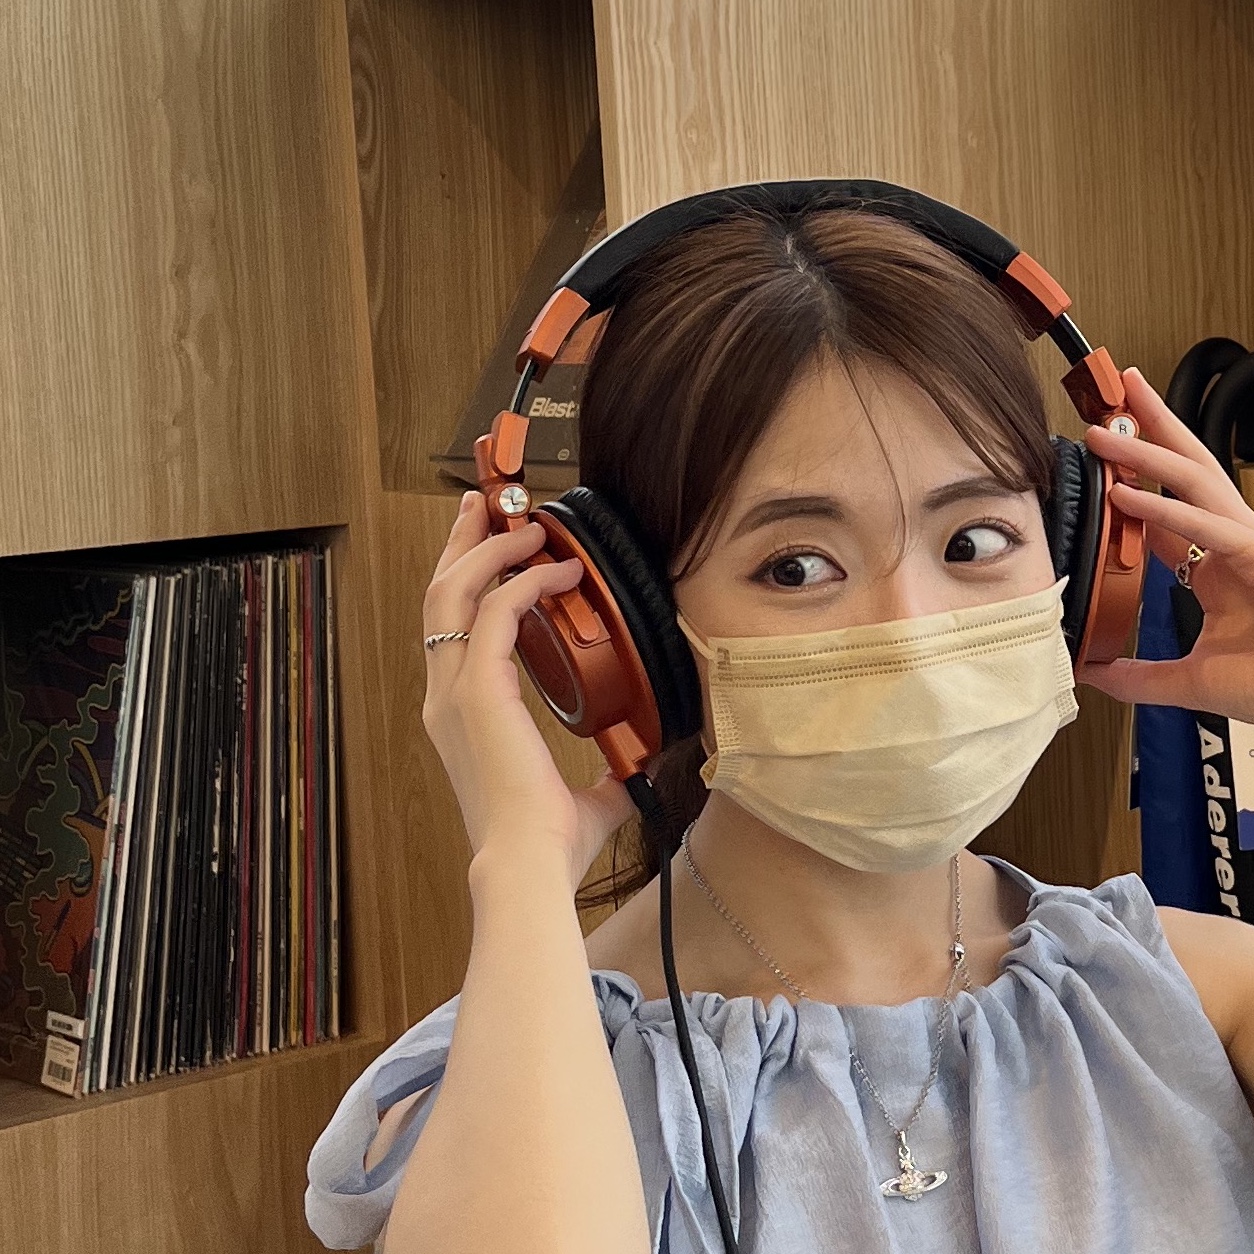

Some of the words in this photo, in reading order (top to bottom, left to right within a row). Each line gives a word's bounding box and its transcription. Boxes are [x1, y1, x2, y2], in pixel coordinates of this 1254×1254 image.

[1118, 423, 1127, 435] R
[509, 495, 519, 506] L
[1196, 720, 1241, 918] Aderer
